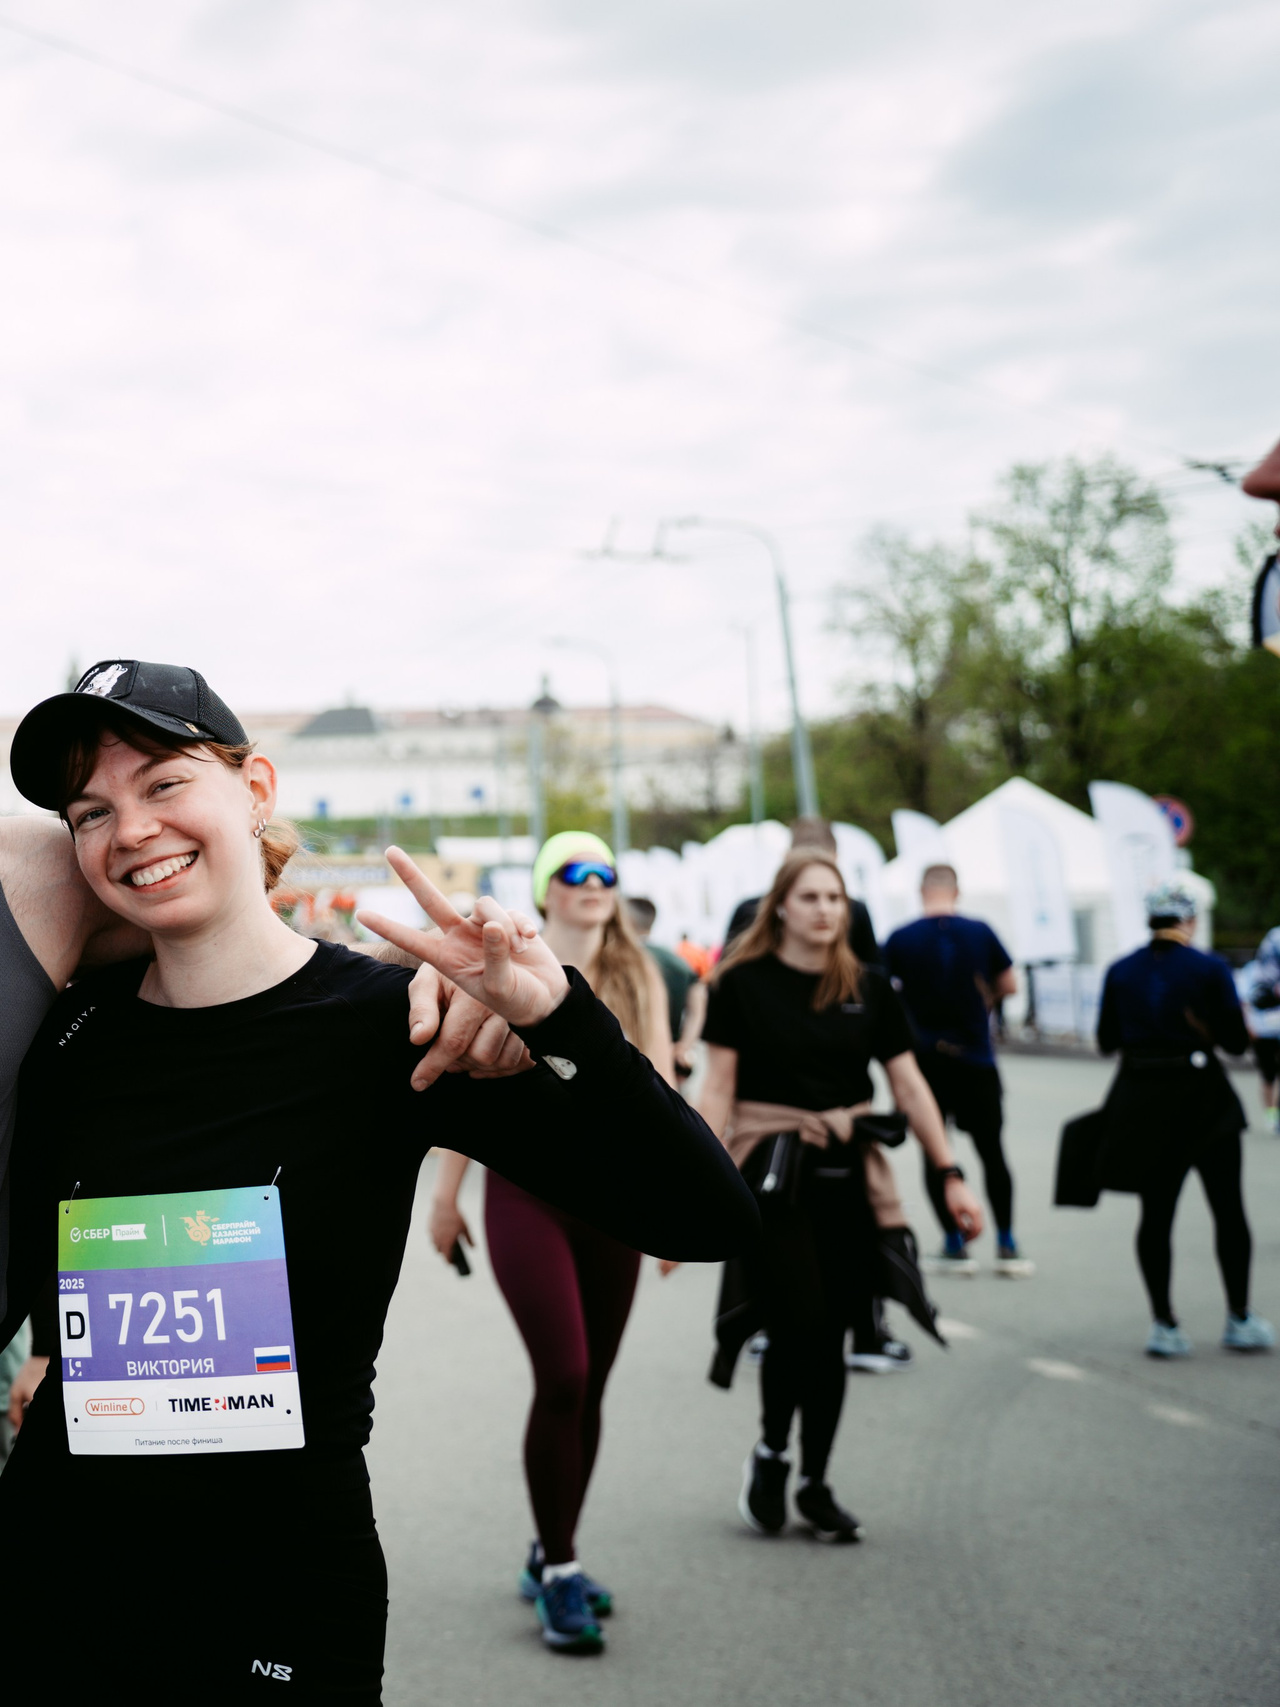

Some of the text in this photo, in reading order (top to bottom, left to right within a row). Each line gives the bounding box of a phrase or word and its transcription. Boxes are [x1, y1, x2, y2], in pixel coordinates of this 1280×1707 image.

[211, 1220, 256, 1230] СБЕРПРАЙМ
[83, 1227, 140, 1239] СБЕР Прайм
[212, 1226, 261, 1238] КАЗАНСКИЙ
[213, 1236, 252, 1245] МАРАФОН
[59, 1278, 85, 1290] 2025
[108, 1288, 226, 1345] 7251
[65, 1311, 86, 1340] D
[126, 1358, 215, 1376] ВИКТОРИЯ
[90, 1402, 128, 1412] Winline
[135, 1438, 166, 1447] Питание
[191, 1437, 223, 1446] финиша
